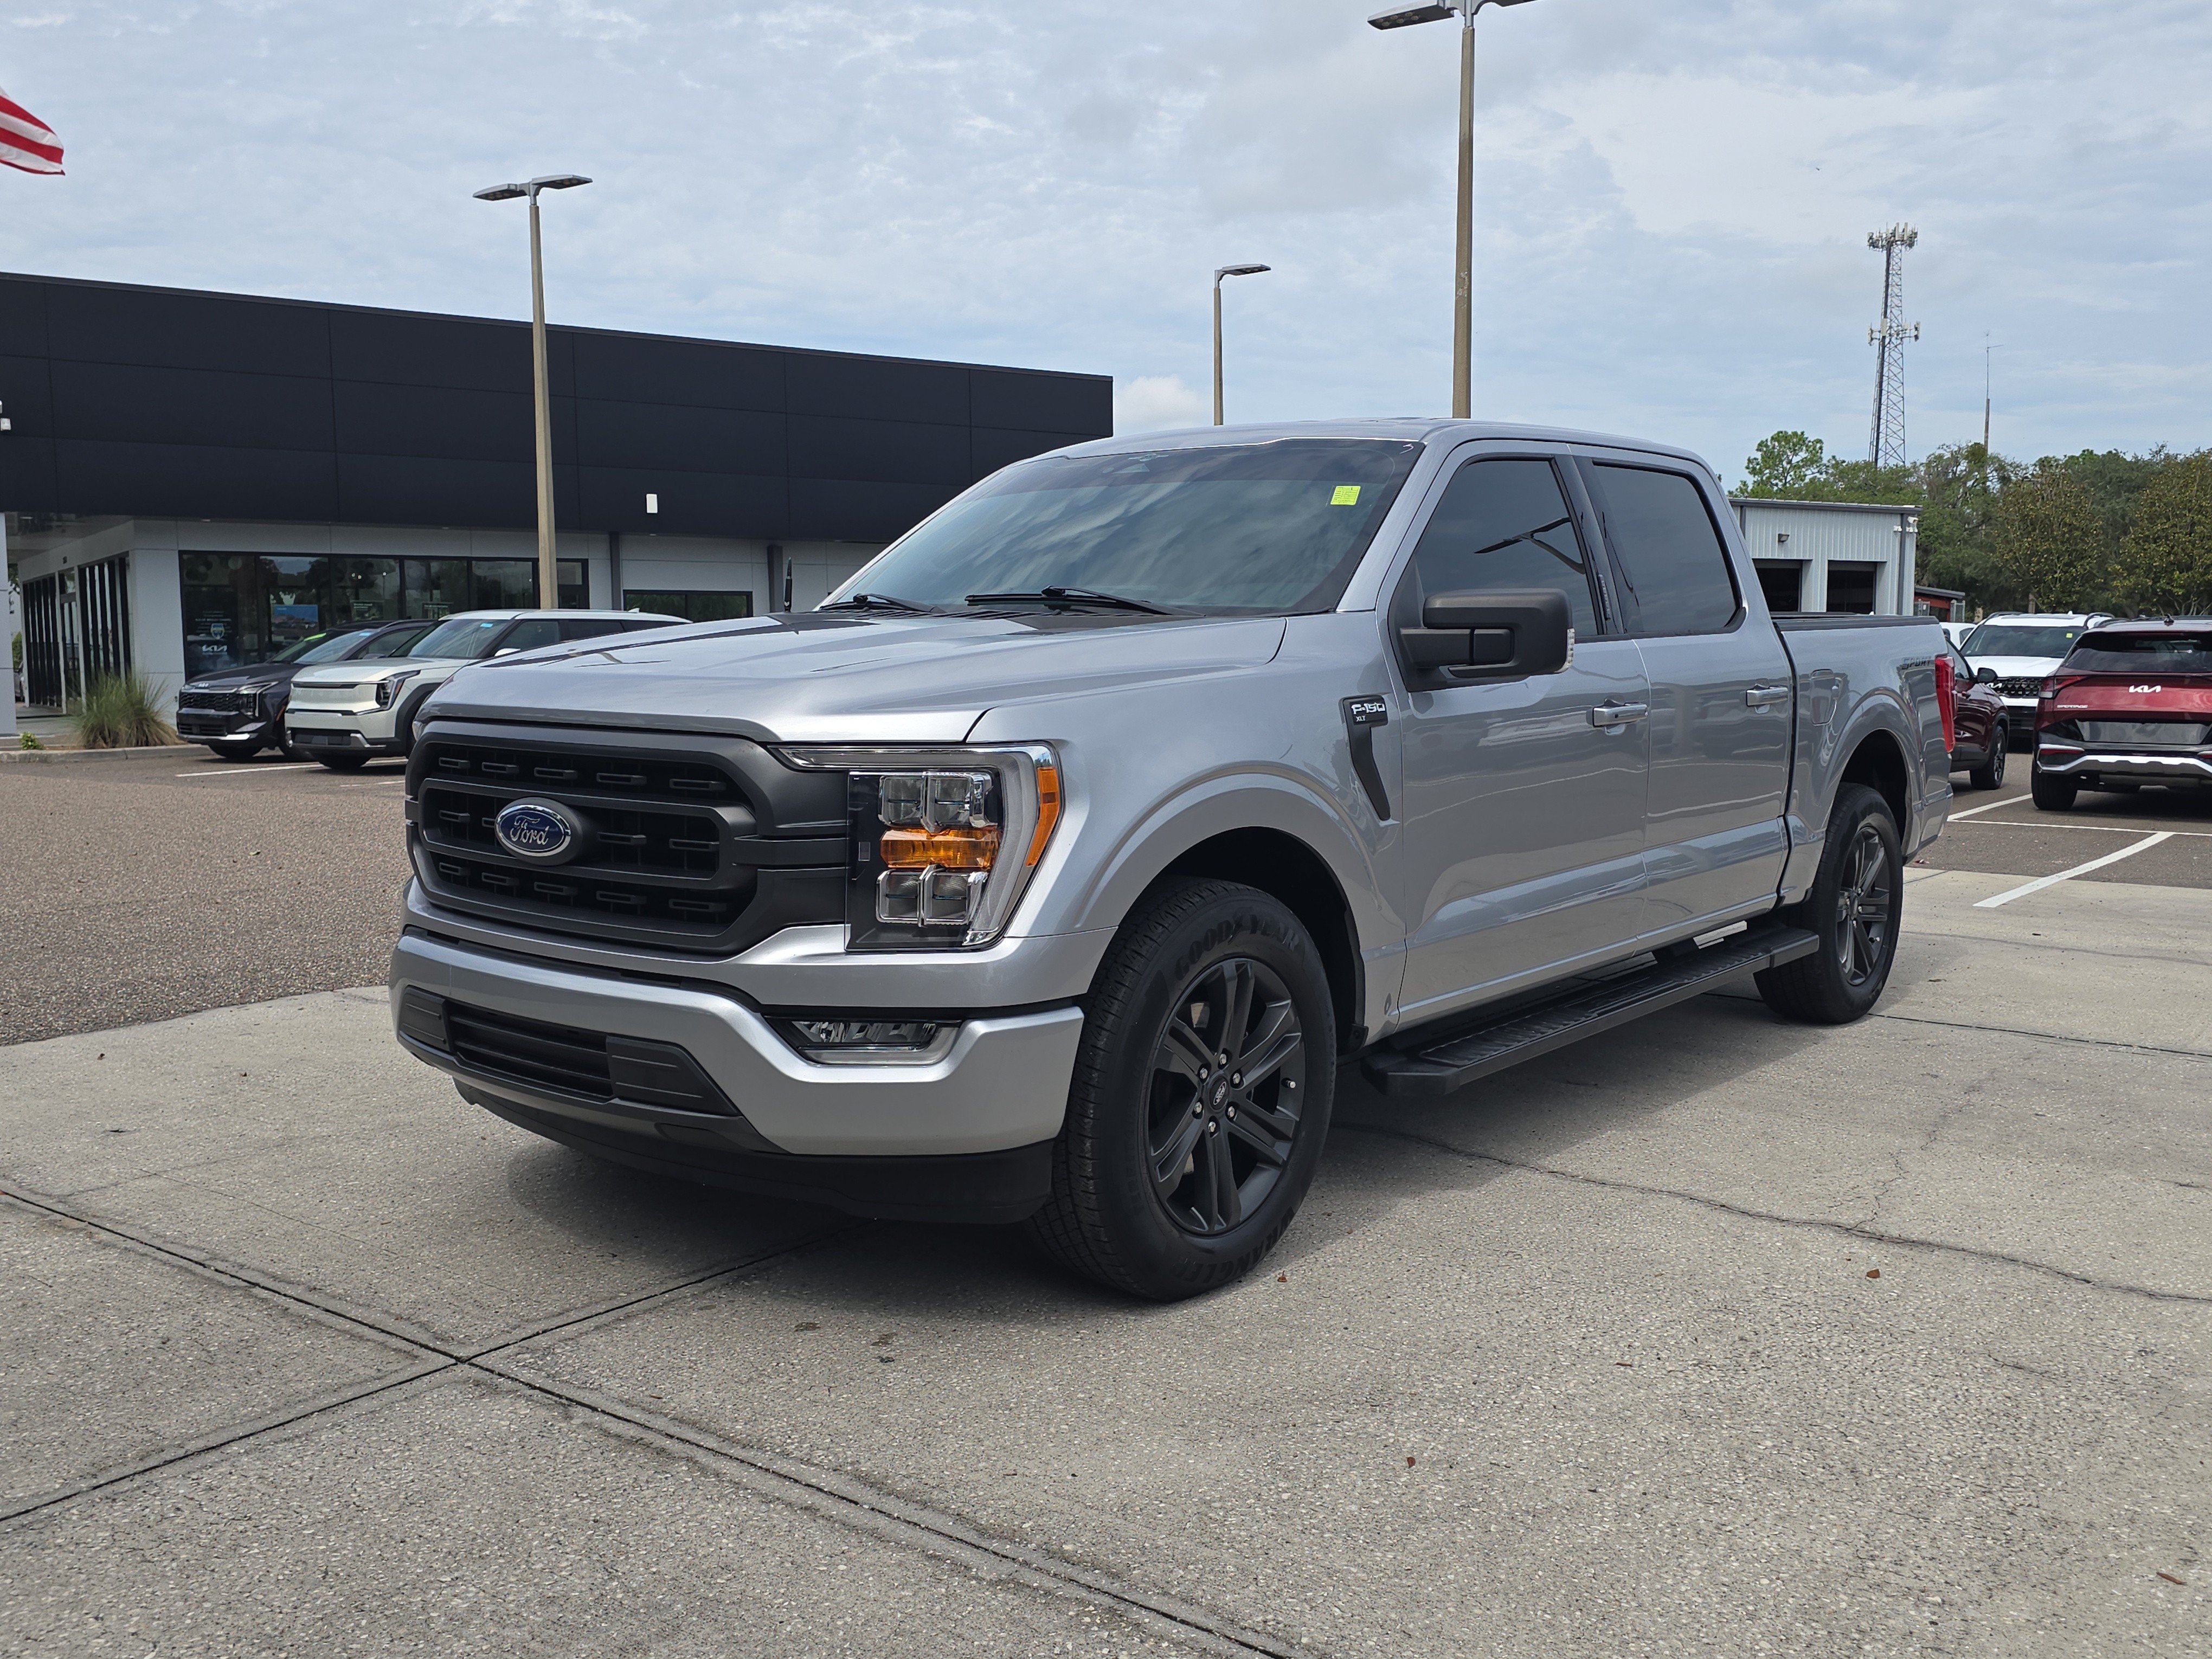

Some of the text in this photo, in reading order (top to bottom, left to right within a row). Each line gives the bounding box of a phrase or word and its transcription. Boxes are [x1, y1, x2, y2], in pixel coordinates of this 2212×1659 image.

[1901, 655, 1932, 670] SPORT
[2129, 685, 2162, 693] KIA
[1352, 702, 1385, 715] F-150
[509, 814, 549, 846] Ford
